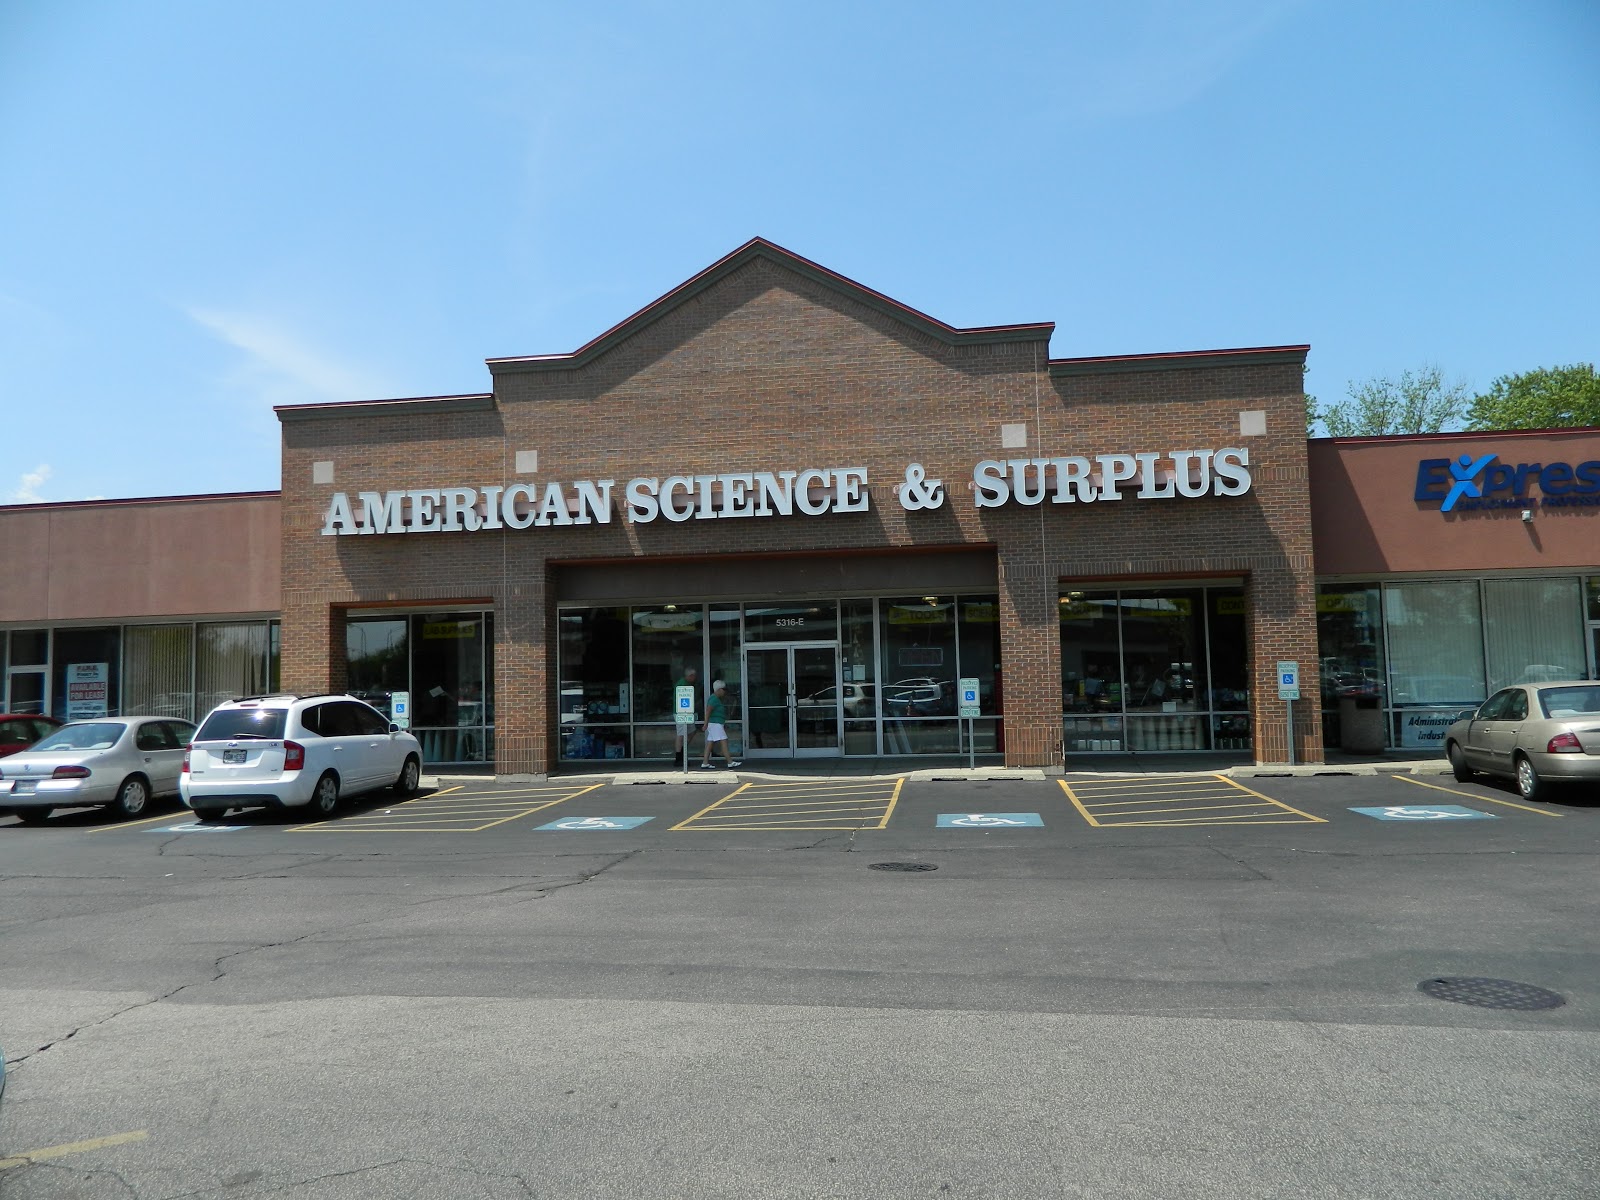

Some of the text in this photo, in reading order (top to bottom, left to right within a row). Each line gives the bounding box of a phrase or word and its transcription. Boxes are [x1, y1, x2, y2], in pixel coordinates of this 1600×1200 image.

[321, 447, 1251, 536] AMERICAN SCIENCE & SURPLUS
[776, 618, 804, 627] 5316-E
[70, 691, 105, 700] FOR LEASE
